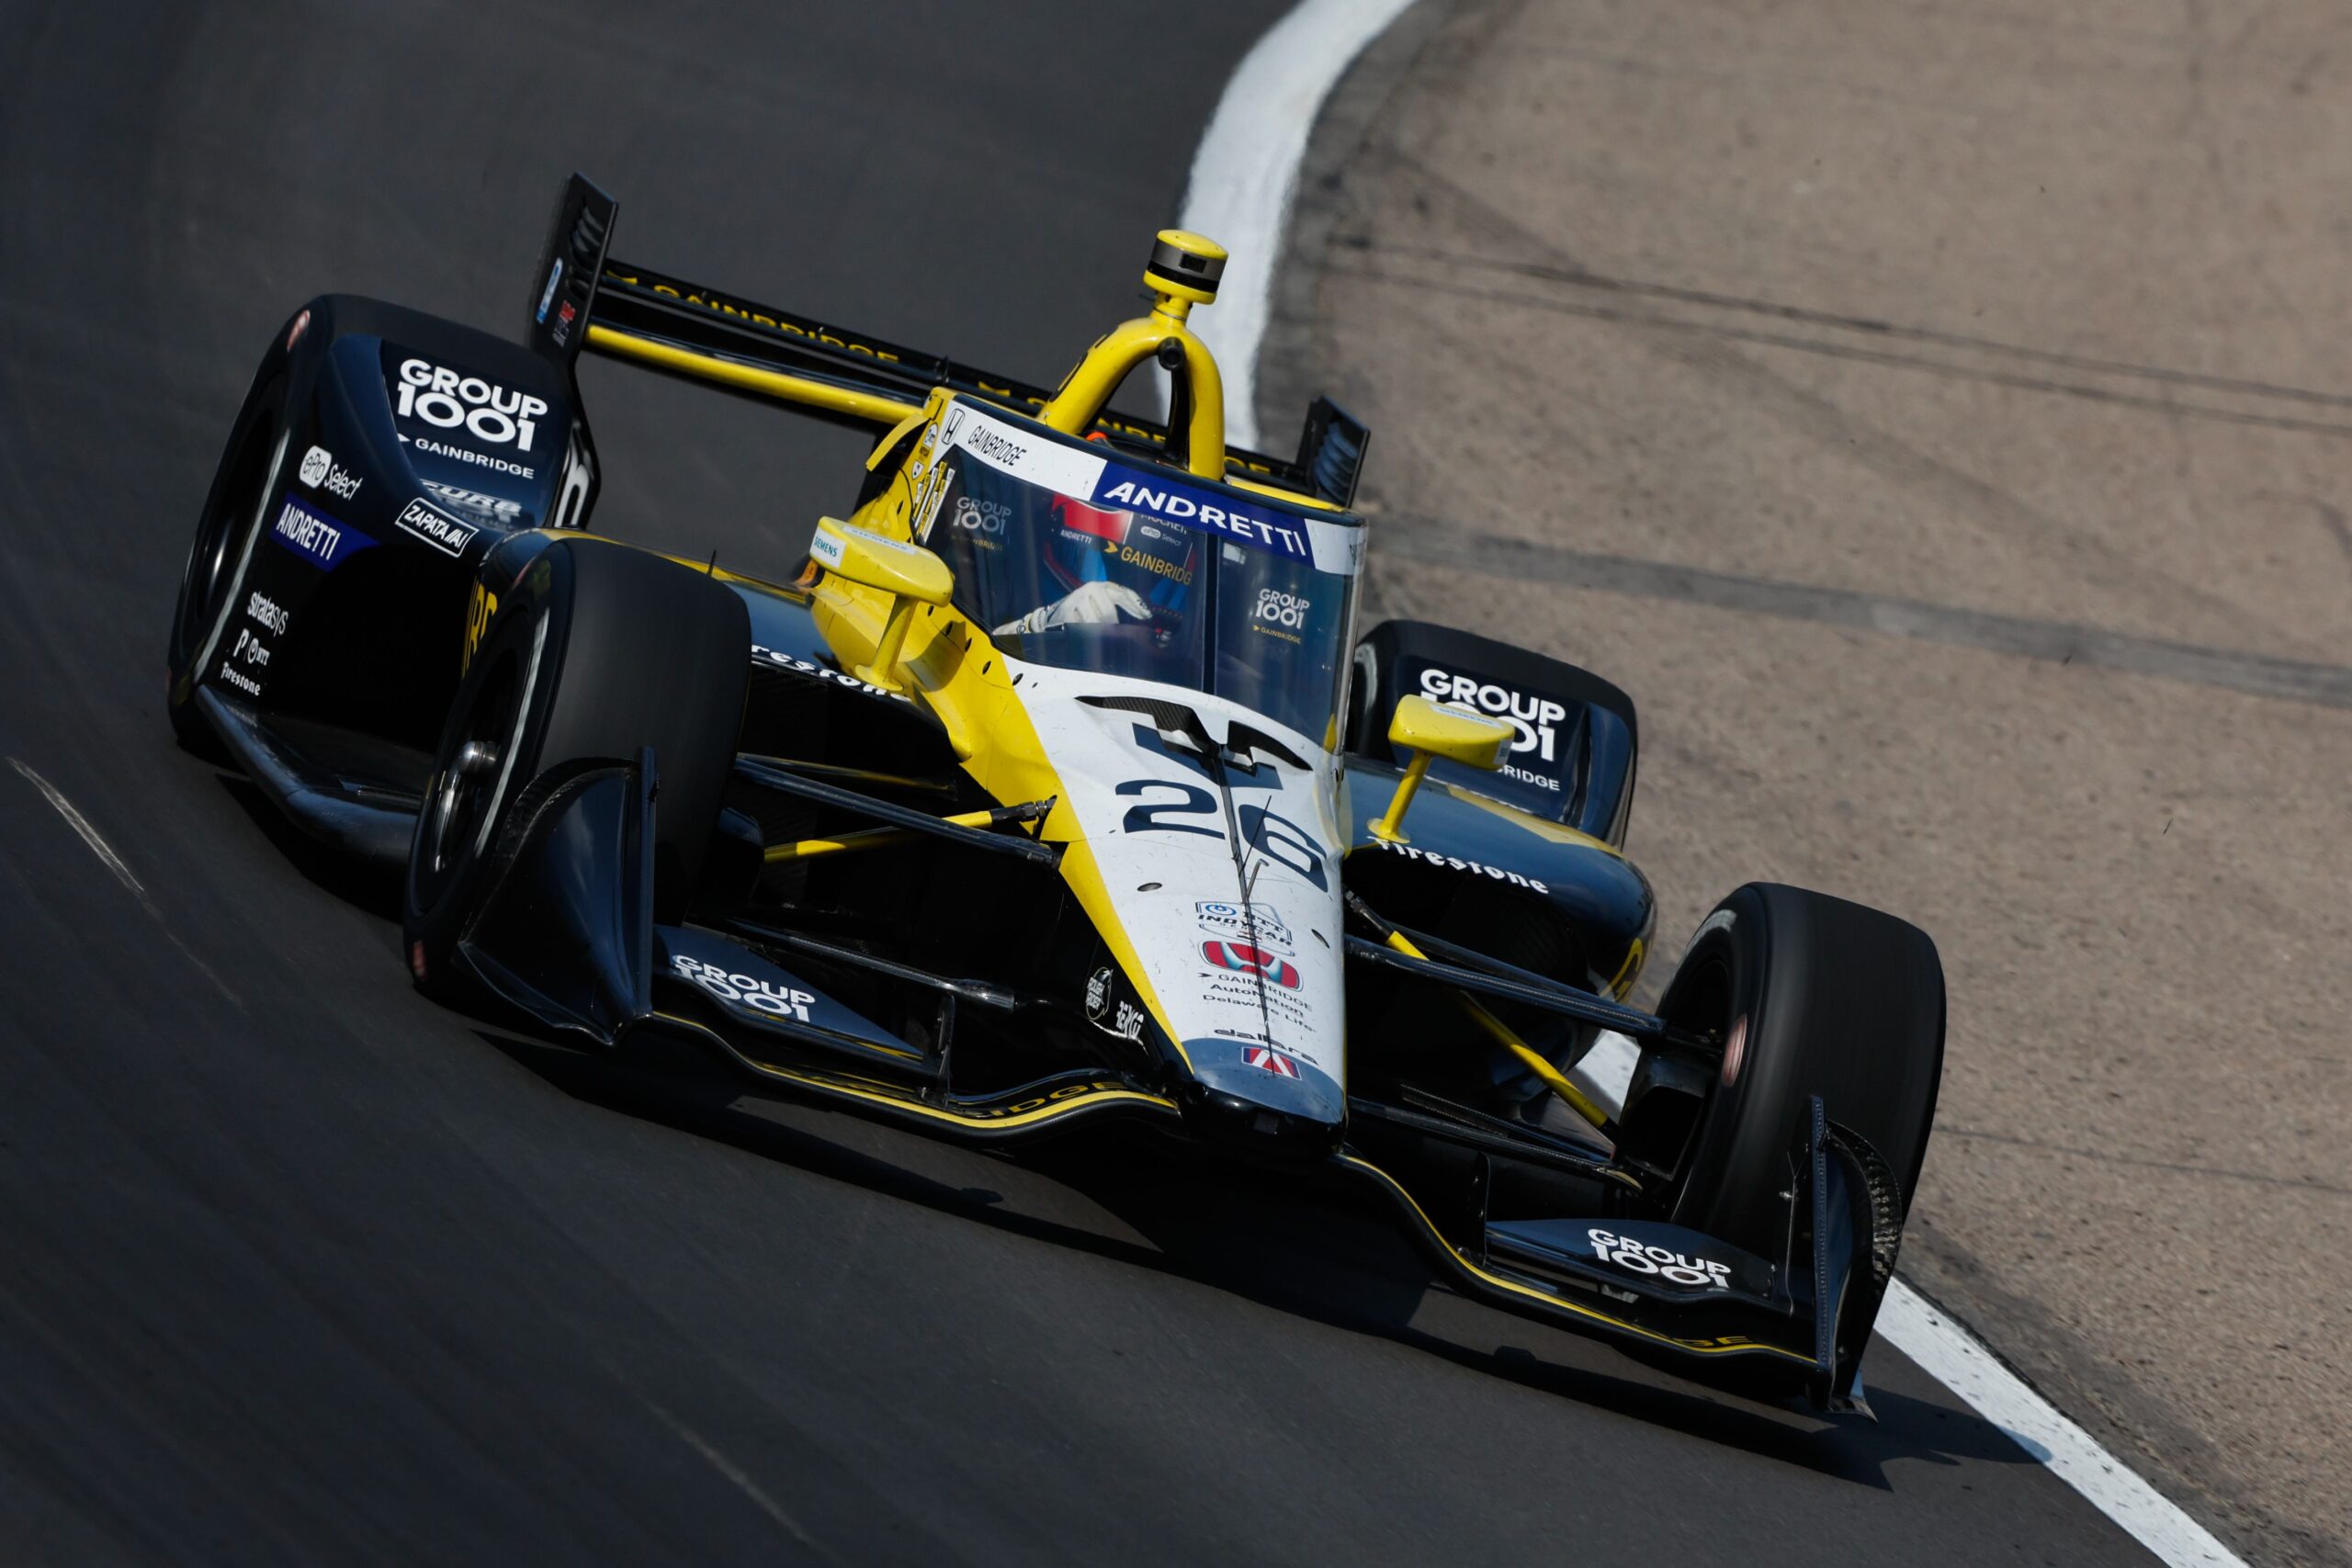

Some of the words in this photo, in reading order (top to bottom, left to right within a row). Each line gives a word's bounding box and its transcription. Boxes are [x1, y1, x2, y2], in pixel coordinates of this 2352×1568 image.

[400, 358, 548, 419] GROUP
[398, 381, 536, 452] 1001
[415, 438, 535, 479] GAINBRIDGE
[967, 425, 1027, 467] GAINBRIDGE
[323, 463, 363, 501] Select
[953, 509, 1007, 535] 1001
[956, 496, 1012, 517] GROUP
[1103, 481, 1306, 557] ANDRETTI
[276, 502, 341, 560] ANDRETTI
[814, 536, 839, 558] SIEMENS
[1060, 529, 1092, 545] ANDRETTI
[247, 591, 289, 637] stratasys
[1255, 601, 1306, 629] 1001
[1259, 588, 1310, 611] GROUP
[1261, 626, 1302, 645] GAINBRIDGE
[220, 661, 261, 696] Firestone
[1419, 669, 1566, 726] GROUP
[1498, 763, 1560, 792] RIDGE
[1114, 778, 1329, 893] 26
[672, 954, 816, 1004] GROUP
[674, 964, 810, 1023] 1001
[1588, 1228, 1732, 1275] GROUP
[1590, 1240, 1730, 1288] 1001
